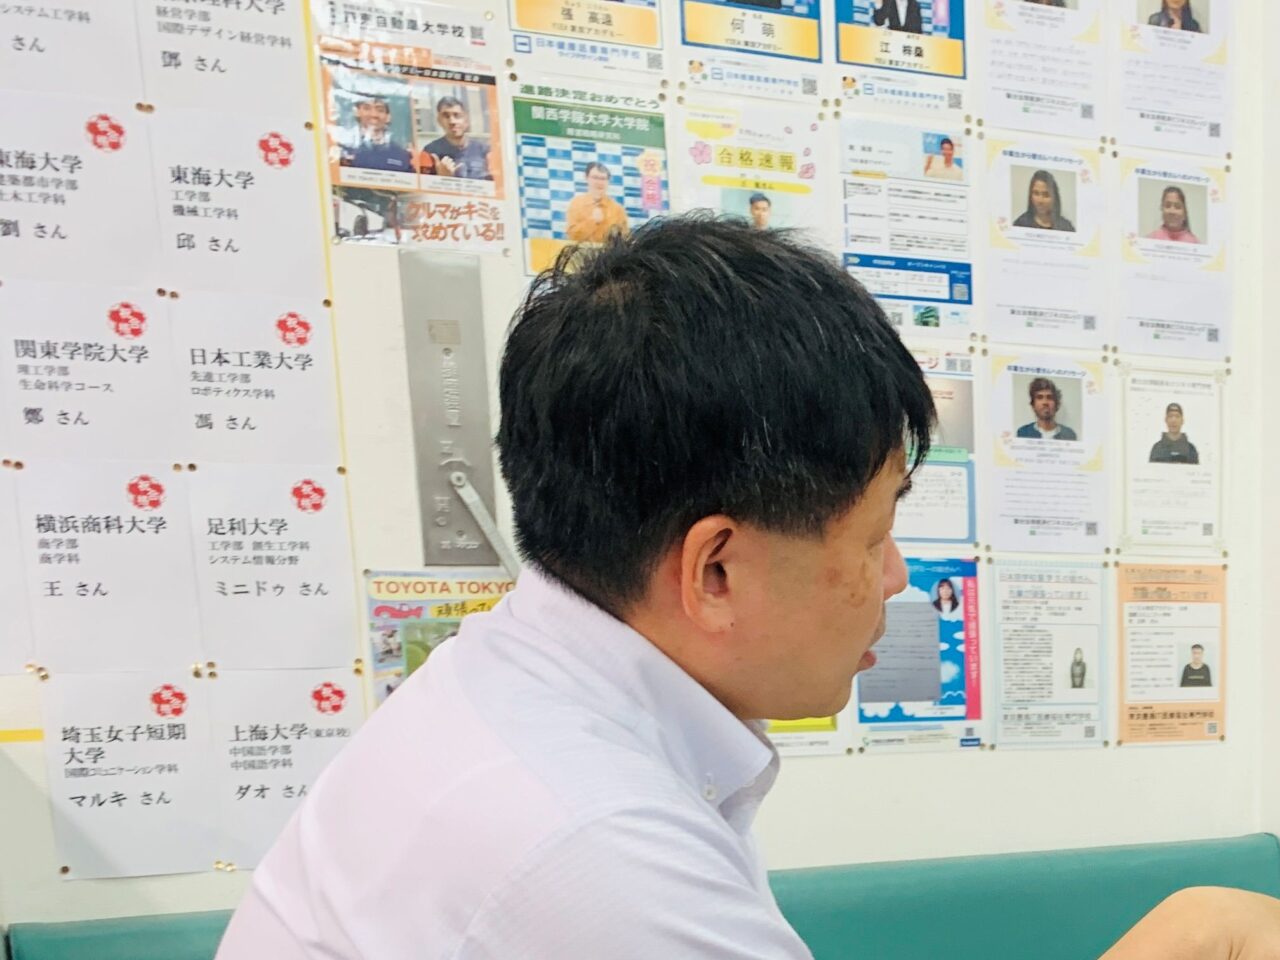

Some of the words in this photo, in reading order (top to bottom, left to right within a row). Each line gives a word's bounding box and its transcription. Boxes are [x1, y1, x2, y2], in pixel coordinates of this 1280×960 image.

[12, 35, 46, 53] さん
[194, 56, 227, 74] さん
[520, 84, 661, 109] 進路決定おめでとう
[531, 106, 650, 131] 関西学院大学大学院
[718, 147, 794, 171] 合格速報
[168, 165, 255, 189] 東海大学
[171, 190, 211, 202] 工学部
[173, 204, 239, 220] 機械工学科
[34, 222, 68, 240] さん
[208, 236, 240, 253] さん
[14, 339, 149, 364] 関東学院大学
[190, 348, 314, 371] 日本工業大学
[19, 378, 115, 393] 生命科学コース
[56, 410, 90, 426] さん
[226, 415, 257, 431] さん
[35, 513, 168, 535] 横浜商科大学
[207, 517, 289, 536] 足利大学
[43, 580, 64, 597] 王
[76, 581, 109, 597] さん
[299, 582, 329, 597] さん
[373, 581, 452, 594] TOYOTA
[61, 723, 187, 743] 埼玉女子短期
[64, 747, 106, 765] 大学
[68, 791, 128, 807] マルキ
[140, 791, 172, 806] さん
[235, 784, 270, 801] ダオ
[282, 784, 308, 799] さん
